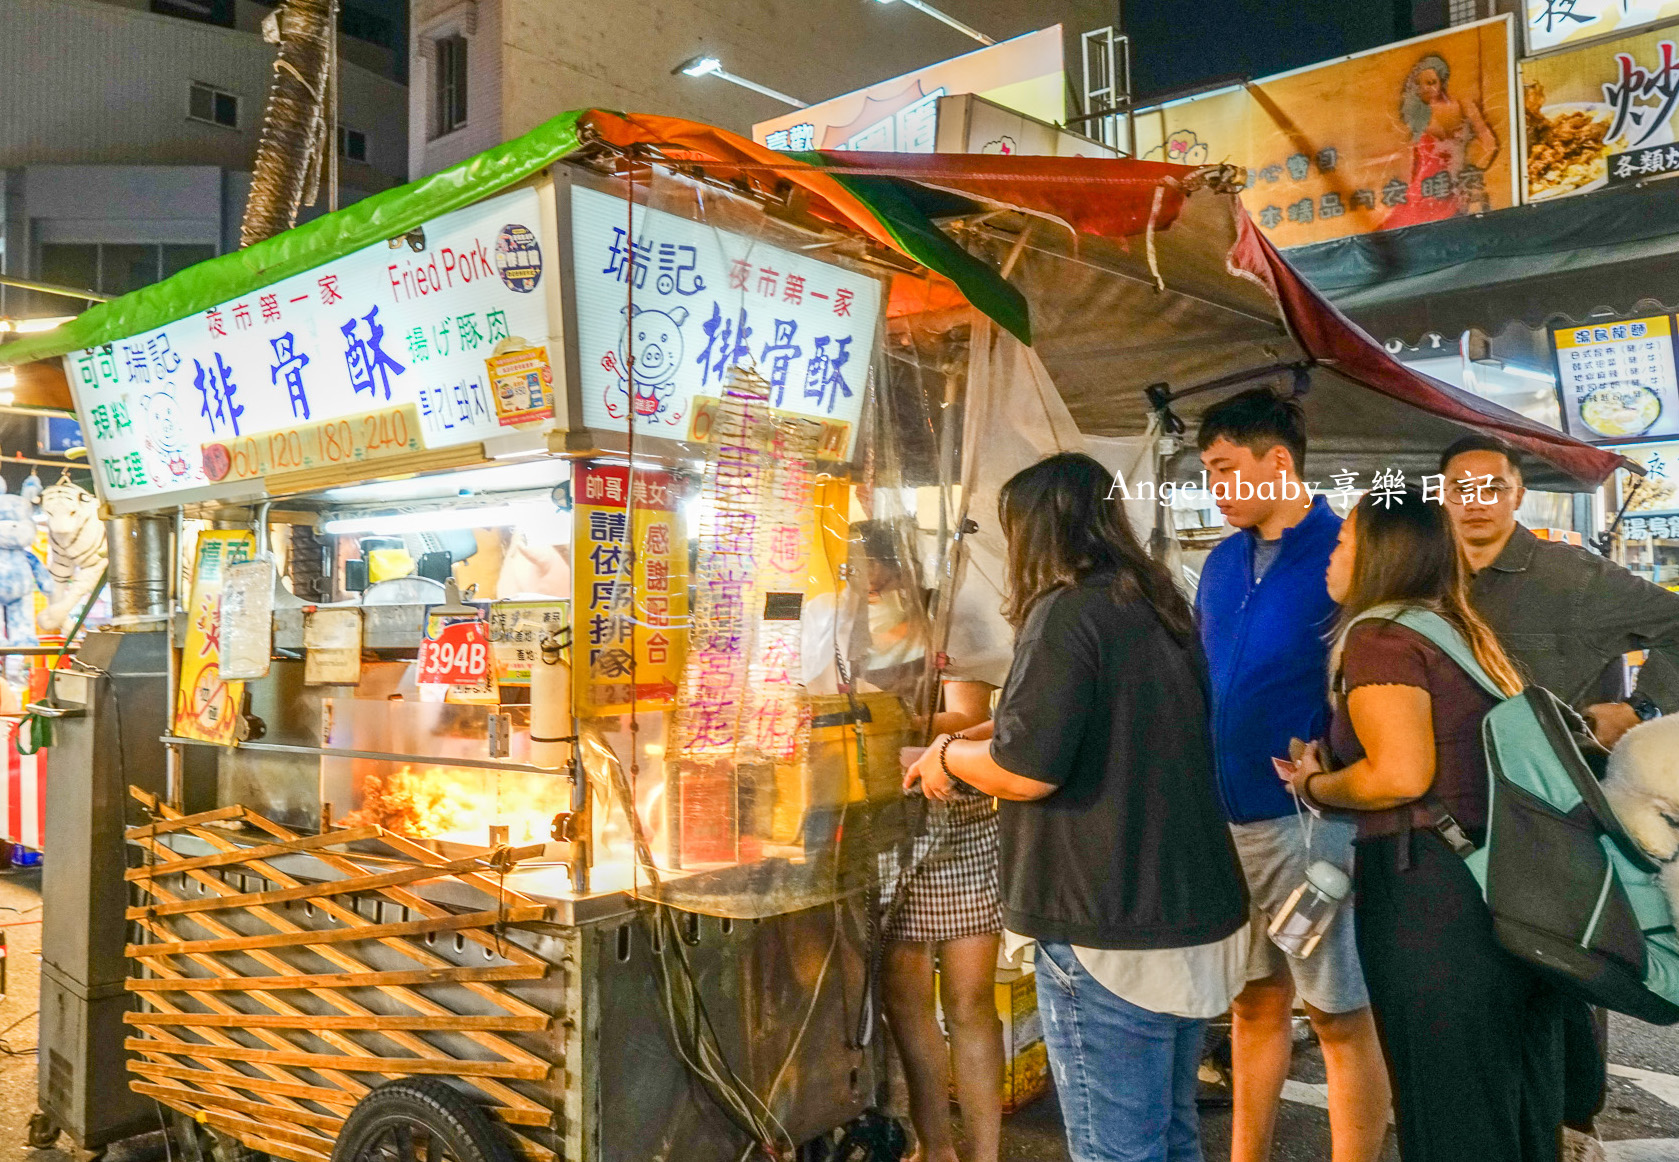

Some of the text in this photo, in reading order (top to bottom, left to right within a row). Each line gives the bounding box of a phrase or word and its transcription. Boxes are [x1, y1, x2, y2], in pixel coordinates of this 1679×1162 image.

[388, 237, 495, 303] Fried Pork
[727, 258, 856, 318] 夜市第一家
[205, 274, 343, 339] 夜市第一家
[404, 306, 511, 364] 揚げ豚肉
[192, 303, 406, 438] 排骨酥
[696, 300, 854, 414] 排骨酥
[425, 642, 487, 675] 394B
